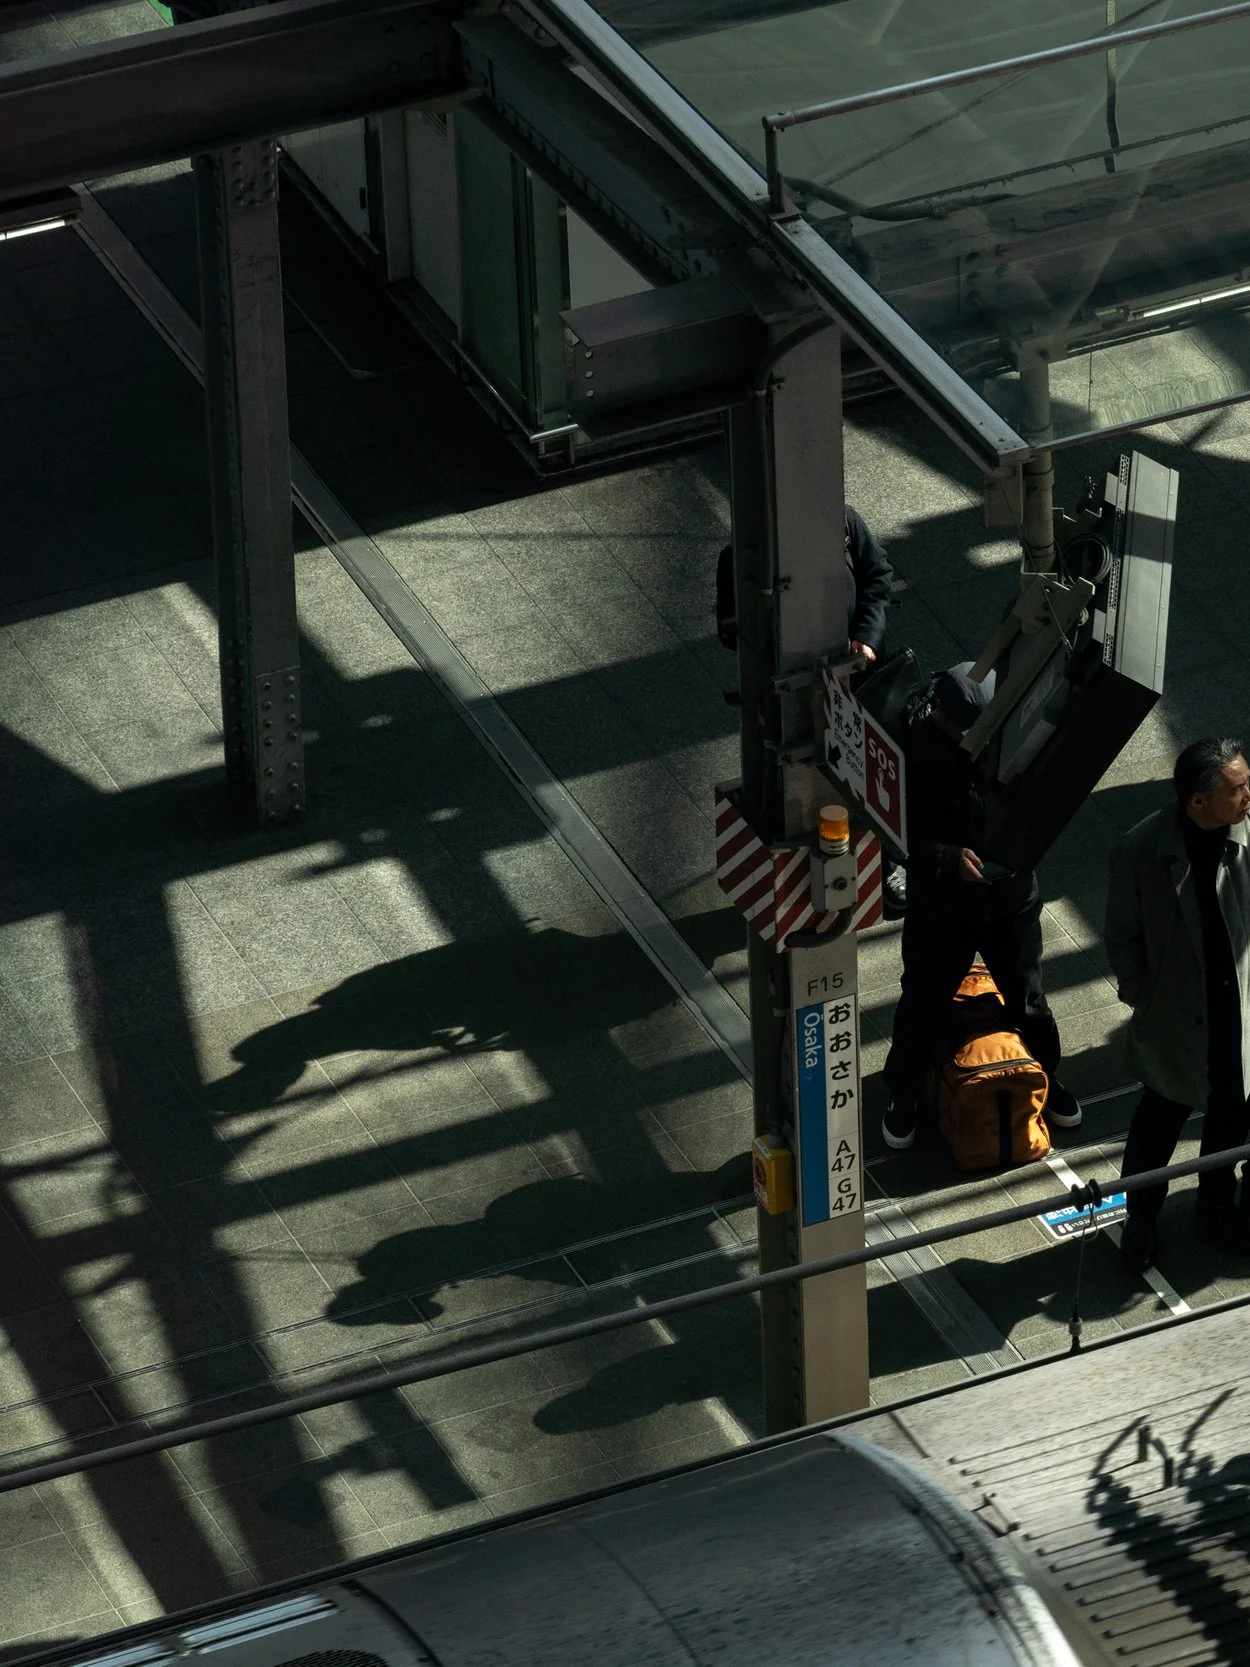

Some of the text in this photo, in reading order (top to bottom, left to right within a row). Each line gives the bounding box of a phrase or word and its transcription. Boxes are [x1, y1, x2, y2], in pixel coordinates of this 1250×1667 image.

[833, 689, 862, 734] 非常
[834, 711, 863, 749] ボタン
[868, 737, 896, 781] SOS
[807, 972, 844, 996] F15
[803, 1012, 824, 1069] Ōsaka
[828, 1002, 854, 1110] おおさか
[831, 1153, 856, 1172] 47
[836, 1140, 851, 1156] A
[837, 1177, 852, 1194] G
[832, 1192, 857, 1211] 47
